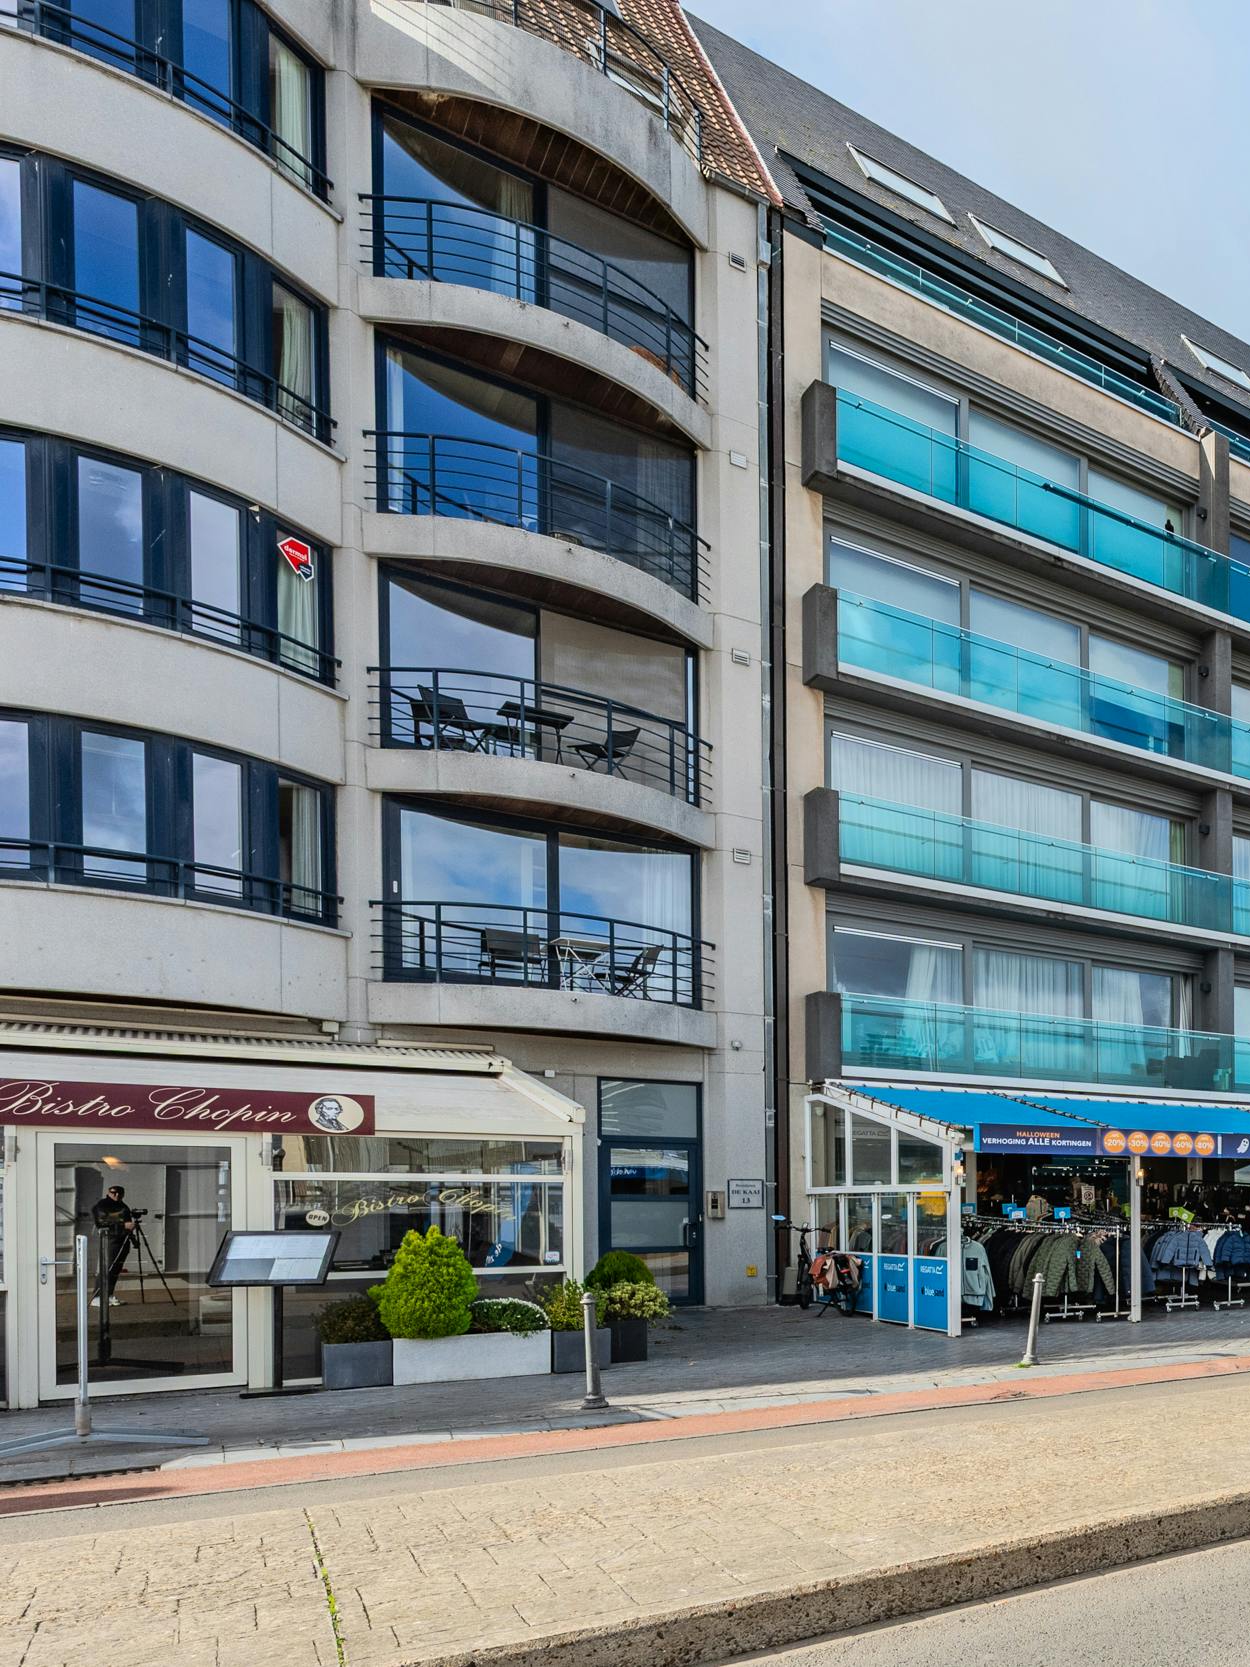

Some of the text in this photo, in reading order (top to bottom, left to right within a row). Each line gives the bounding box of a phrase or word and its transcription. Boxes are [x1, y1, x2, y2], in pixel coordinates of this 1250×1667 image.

[0, 1080, 297, 1130] Bistro Chopin
[1016, 1130, 1060, 1138] HALLOWEEN
[982, 1137, 1092, 1147] VERHOGING ALLE KORTINGEN
[331, 1194, 420, 1227] Bistro
[307, 1213, 329, 1223] OPEN
